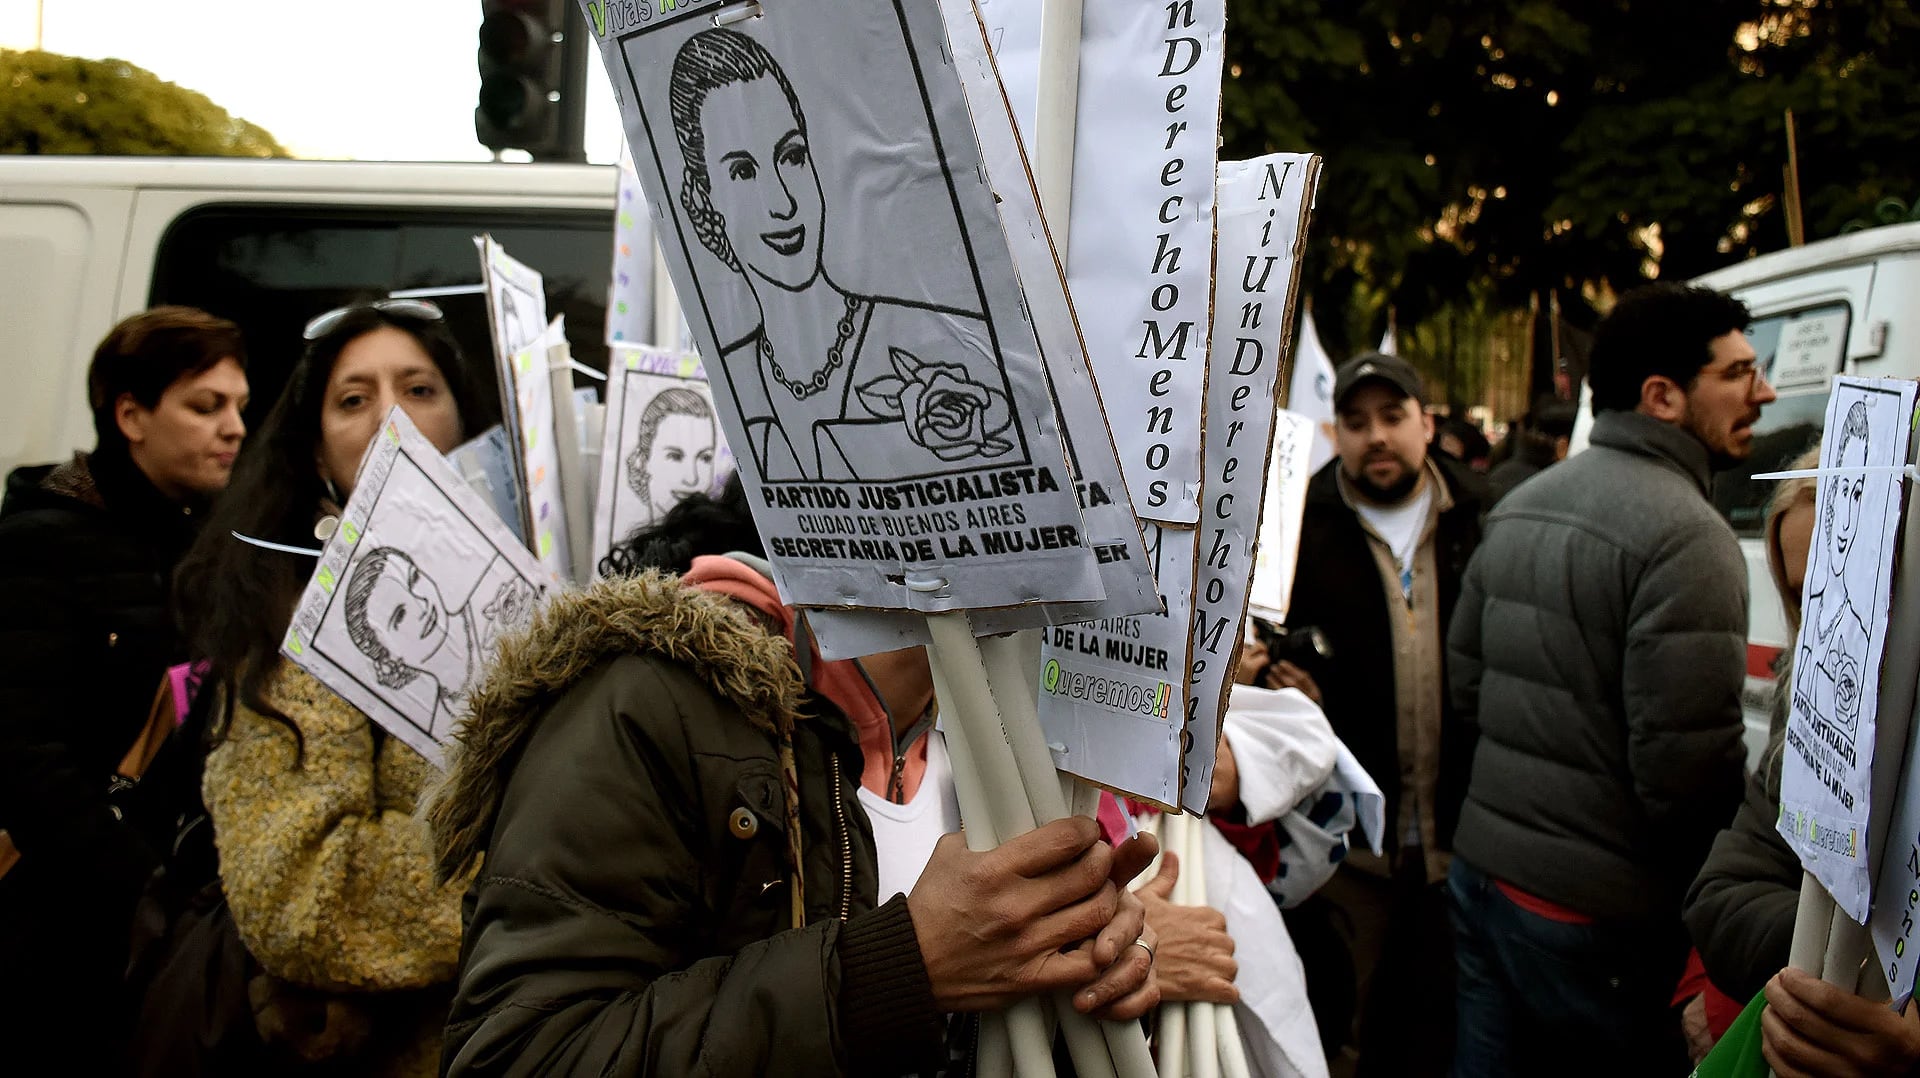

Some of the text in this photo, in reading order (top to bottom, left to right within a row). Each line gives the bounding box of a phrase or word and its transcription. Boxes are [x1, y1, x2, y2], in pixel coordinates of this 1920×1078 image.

[587, 0, 653, 37] Vivas
[761, 486, 851, 509] PARTIDO
[857, 466, 1060, 511] JUSTICIALISTA
[797, 502, 1027, 538] CIUDAD DE BUENOS AIRES
[770, 537, 900, 561] SECRETARIA
[899, 538, 937, 563] DE
[939, 533, 979, 560] LA
[980, 524, 1080, 556] MUJER
[1100, 616, 1141, 639] AIRES
[1053, 627, 1075, 651] DE
[1079, 633, 1100, 657] LA
[1105, 638, 1169, 672] MUJER
[1042, 658, 1172, 719] Queremos!!
